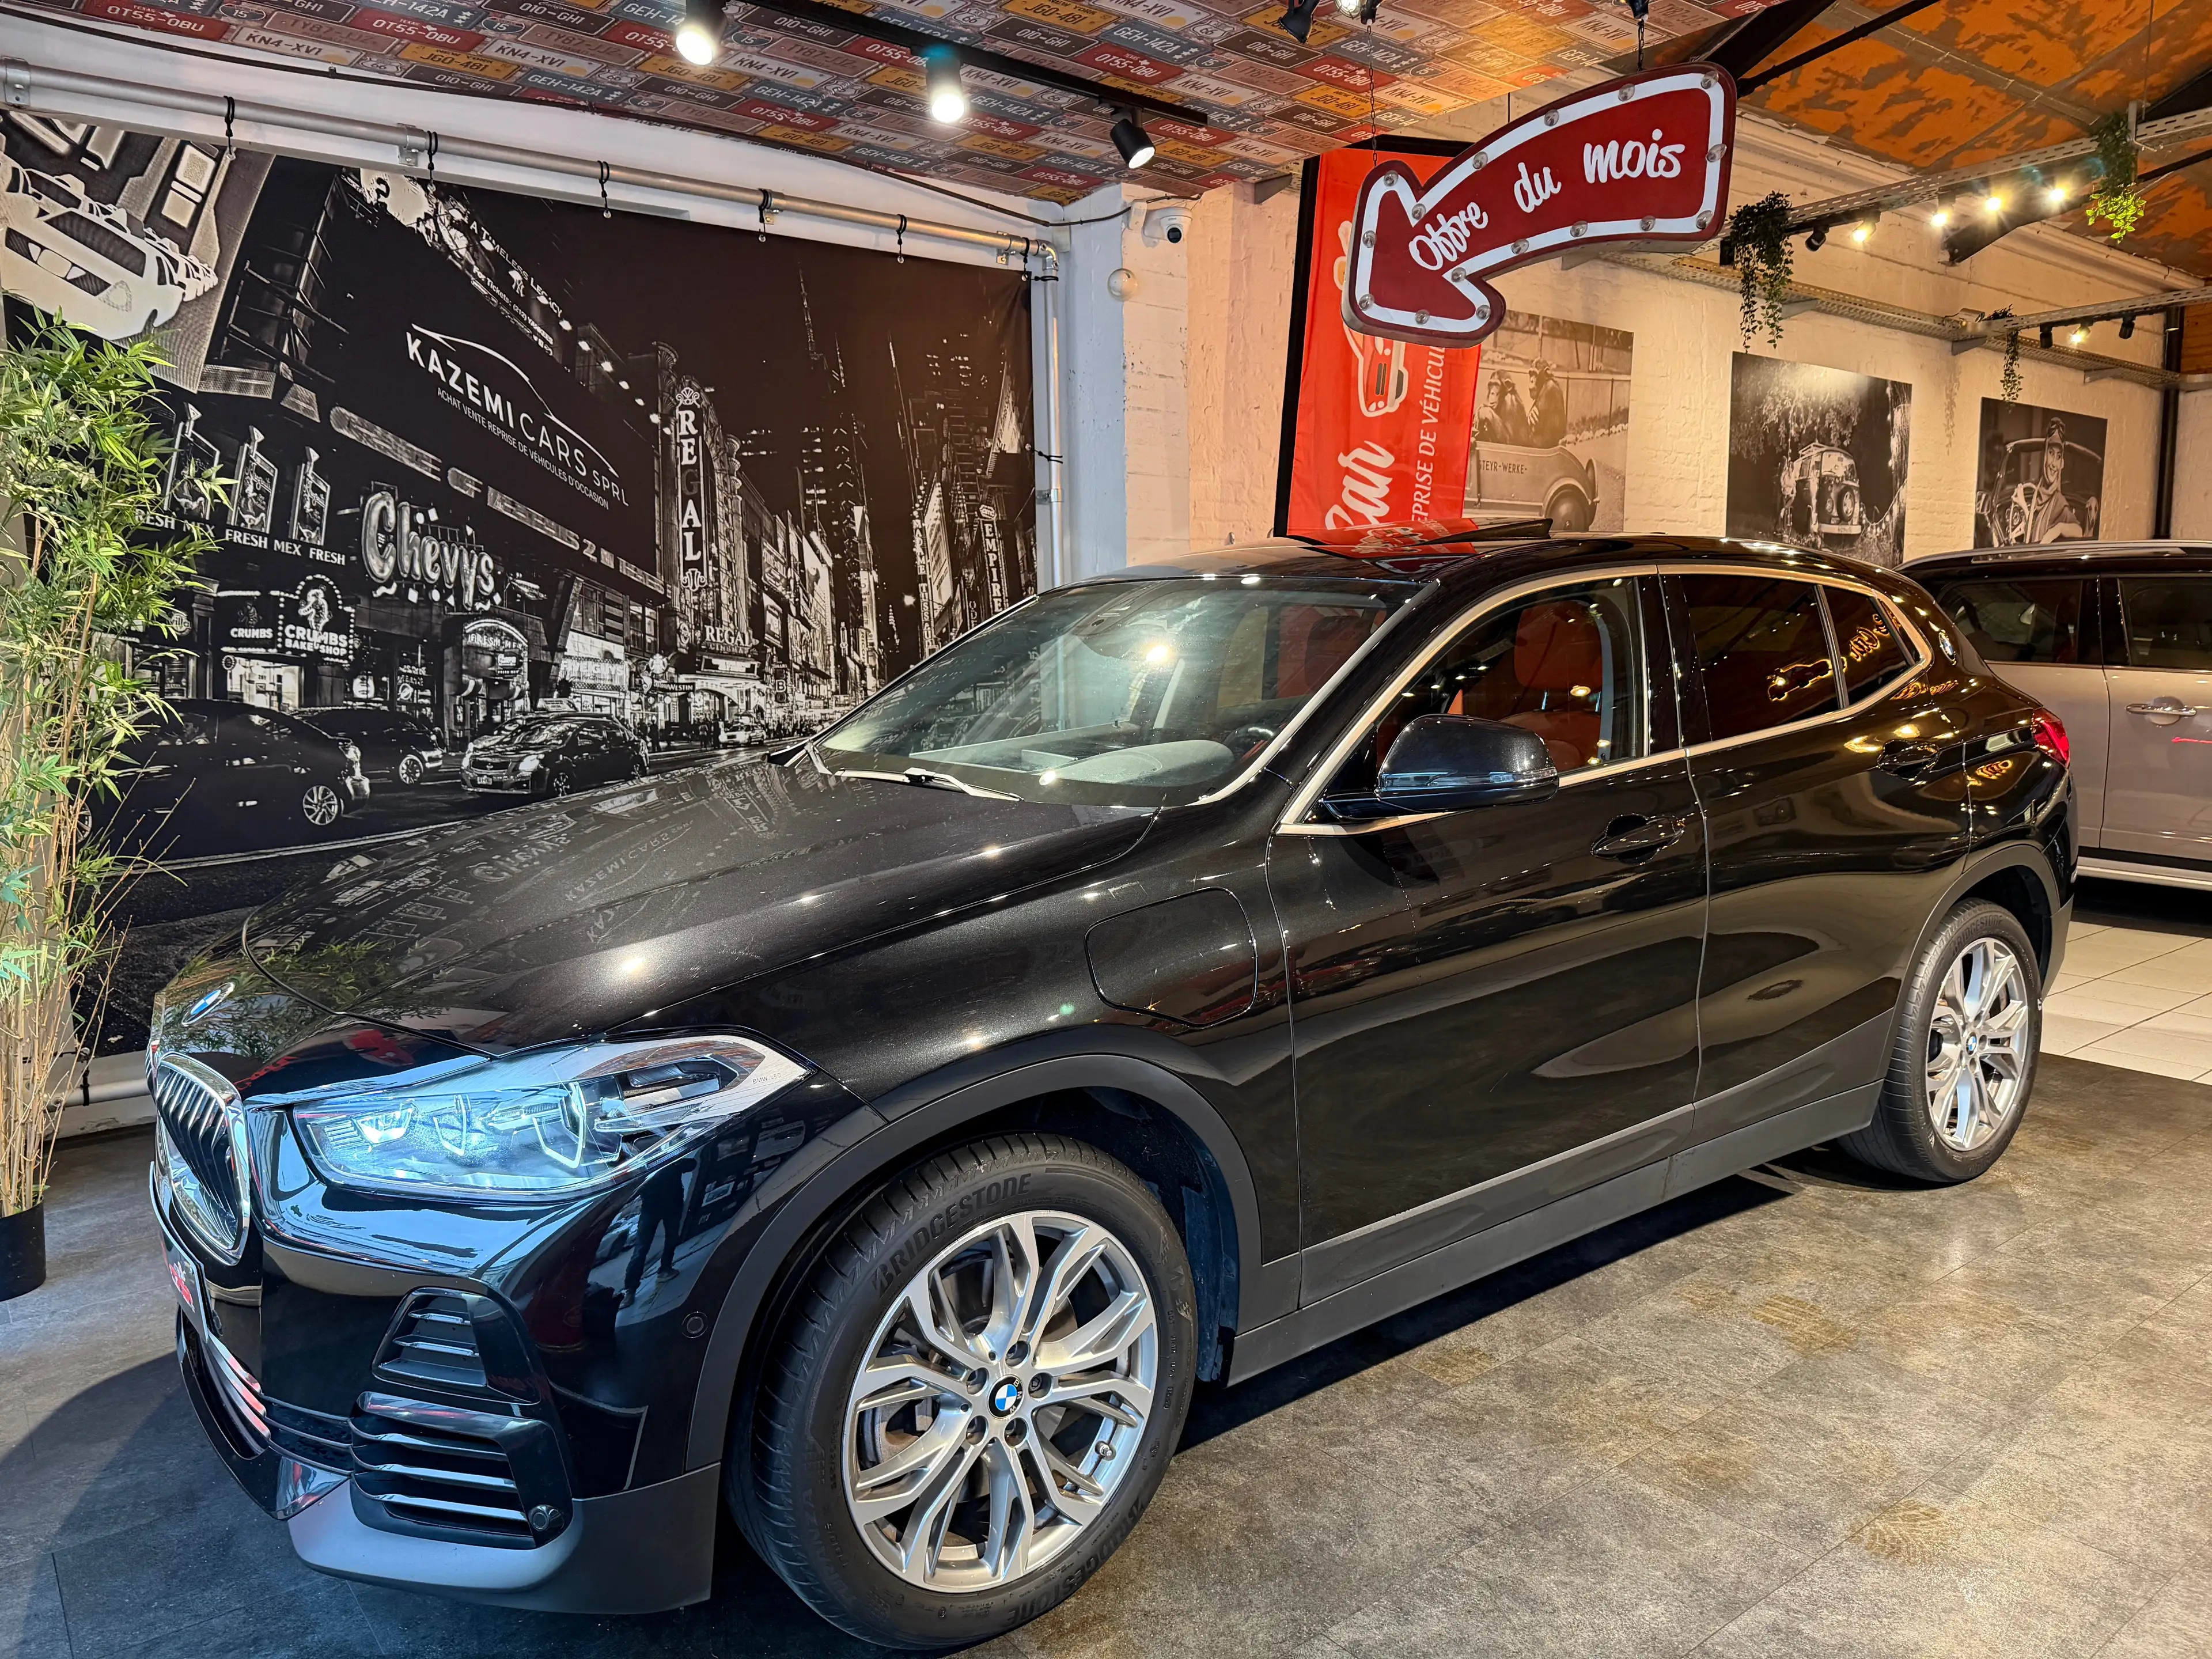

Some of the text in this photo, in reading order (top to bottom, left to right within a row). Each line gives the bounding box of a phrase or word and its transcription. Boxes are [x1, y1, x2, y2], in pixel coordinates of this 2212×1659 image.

[233, 9, 248, 18] 15
[623, 2, 685, 25] GEH-14
[961, 15, 976, 24] 66
[493, 22, 507, 31] 15
[741, 36, 755, 44] 15
[1113, 27, 1180, 54] GEH-142A
[1202, 58, 1215, 66] 15
[1418, 66, 1431, 74] 15
[1408, 128, 1685, 271] Offre du mois
[470, 221, 478, 234] A
[485, 277, 512, 306] Tickets:
[406, 332, 514, 429] KAZEMI
[520, 412, 586, 476] CARS
[593, 472, 629, 506] SPRL
[1412, 346, 1445, 521] EPRISE DE VÉHICUL
[437, 387, 609, 510] ACHAT VENTE REPRISE DE VÉHICULES D'OCCASION
[678, 410, 702, 561] REGAL
[135, 508, 346, 566] RESH MEX FRESH MEX FRESH
[912, 519, 927, 575] MADAME
[361, 491, 495, 611] Chevys
[983, 522, 1003, 613] EMPIRE
[230, 627, 274, 639] CRUMBS
[285, 624, 349, 648] CRUMBS
[468, 633, 501, 647] FRESH
[704, 625, 752, 647] REGAL
[285, 638, 347, 657] BAKE SHOP
[561, 660, 624, 676] FIVE GUYS
[668, 683, 694, 691] WESTIN
[871, 1172, 1032, 1300] BRIDGESTONE
[1009, 1379, 1023, 1414] BMW
